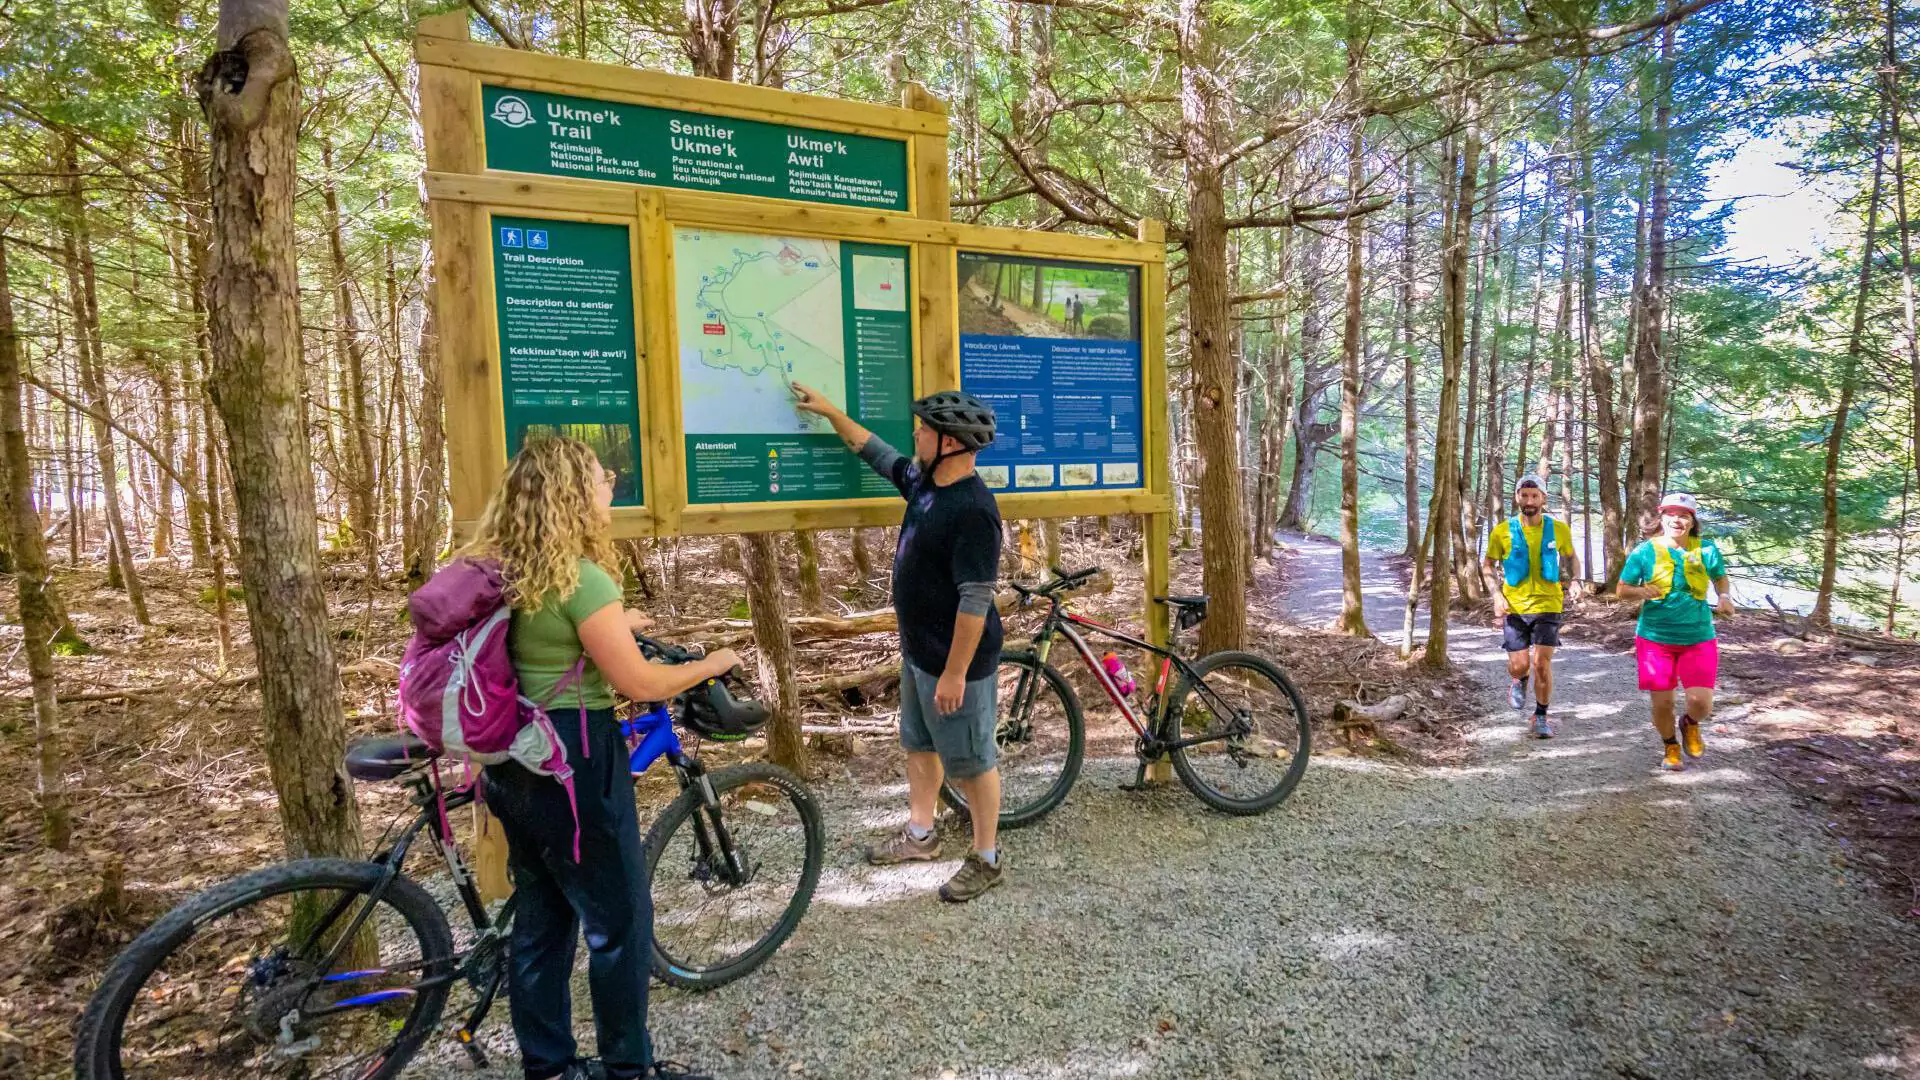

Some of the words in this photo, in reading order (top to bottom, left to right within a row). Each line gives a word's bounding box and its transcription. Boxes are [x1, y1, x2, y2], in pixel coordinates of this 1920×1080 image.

[547, 121, 592, 140] Trail
[669, 119, 735, 140] Sentier
[550, 141, 603, 155] Kejimkujik
[550, 151, 593, 163] National
[596, 155, 619, 166] Park
[621, 159, 640, 168] and
[672, 155, 694, 165] Parc
[696, 159, 733, 170] national
[787, 151, 824, 168] Awti
[551, 160, 594, 172] National
[596, 165, 636, 176] Historic
[637, 169, 657, 179] Site
[672, 165, 690, 173] lieu
[692, 167, 737, 179] historique
[739, 172, 775, 183] national
[788, 169, 832, 182] Kejimkujik
[673, 173, 721, 186] Kejimkujik
[834, 183, 881, 195] Maqamikew
[849, 192, 896, 204] Maqamikew
[503, 252, 525, 263] Trail
[527, 254, 584, 266] Description
[506, 296, 564, 308] Description
[565, 299, 579, 308] du
[581, 301, 614, 310] sentier
[964, 341, 998, 352] Introducing
[582, 349, 599, 359] wjit
[695, 442, 737, 451] Attention!
